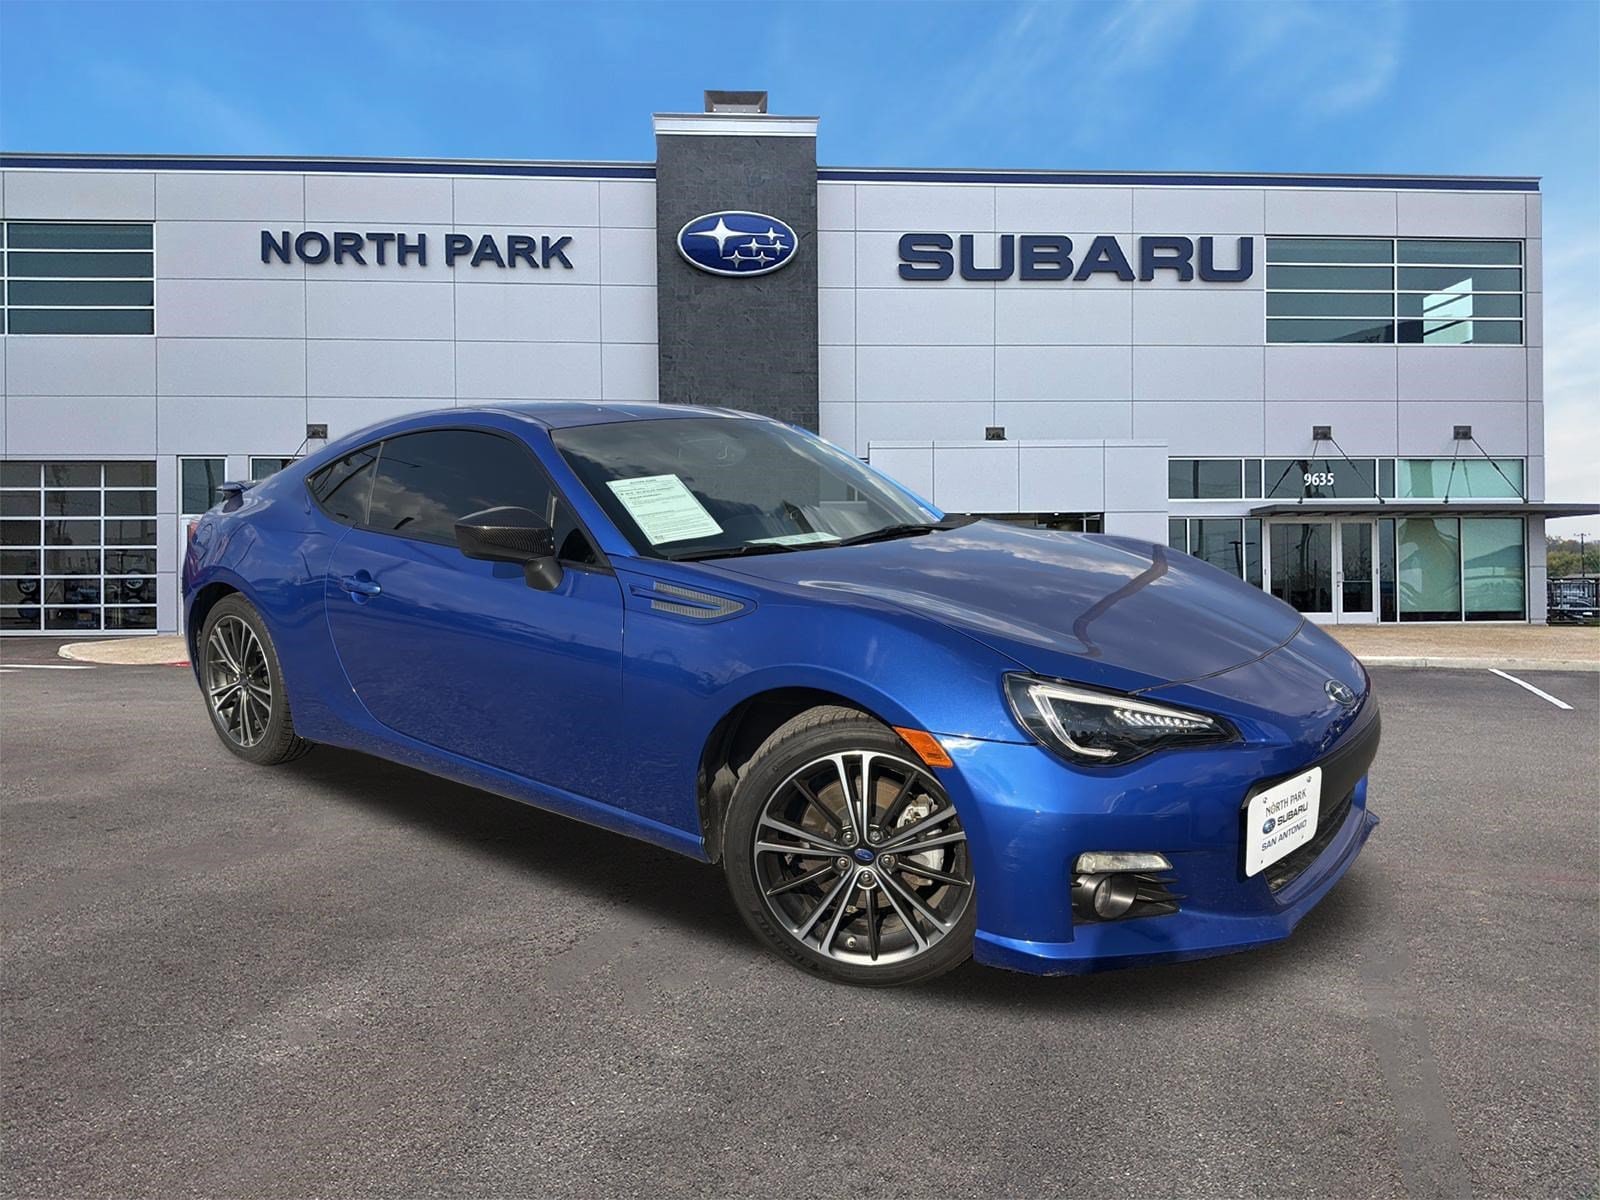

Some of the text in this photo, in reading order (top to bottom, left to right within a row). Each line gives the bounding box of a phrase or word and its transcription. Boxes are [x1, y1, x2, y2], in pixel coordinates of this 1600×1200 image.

[260, 230, 574, 269] NORTH PARK
[898, 232, 1254, 283] SUBARU
[1303, 472, 1335, 486] 9635
[1265, 788, 1307, 818] NORTH PARK
[1277, 802, 1309, 826] SUBARU
[1261, 819, 1308, 852] SAN ANTONIO
